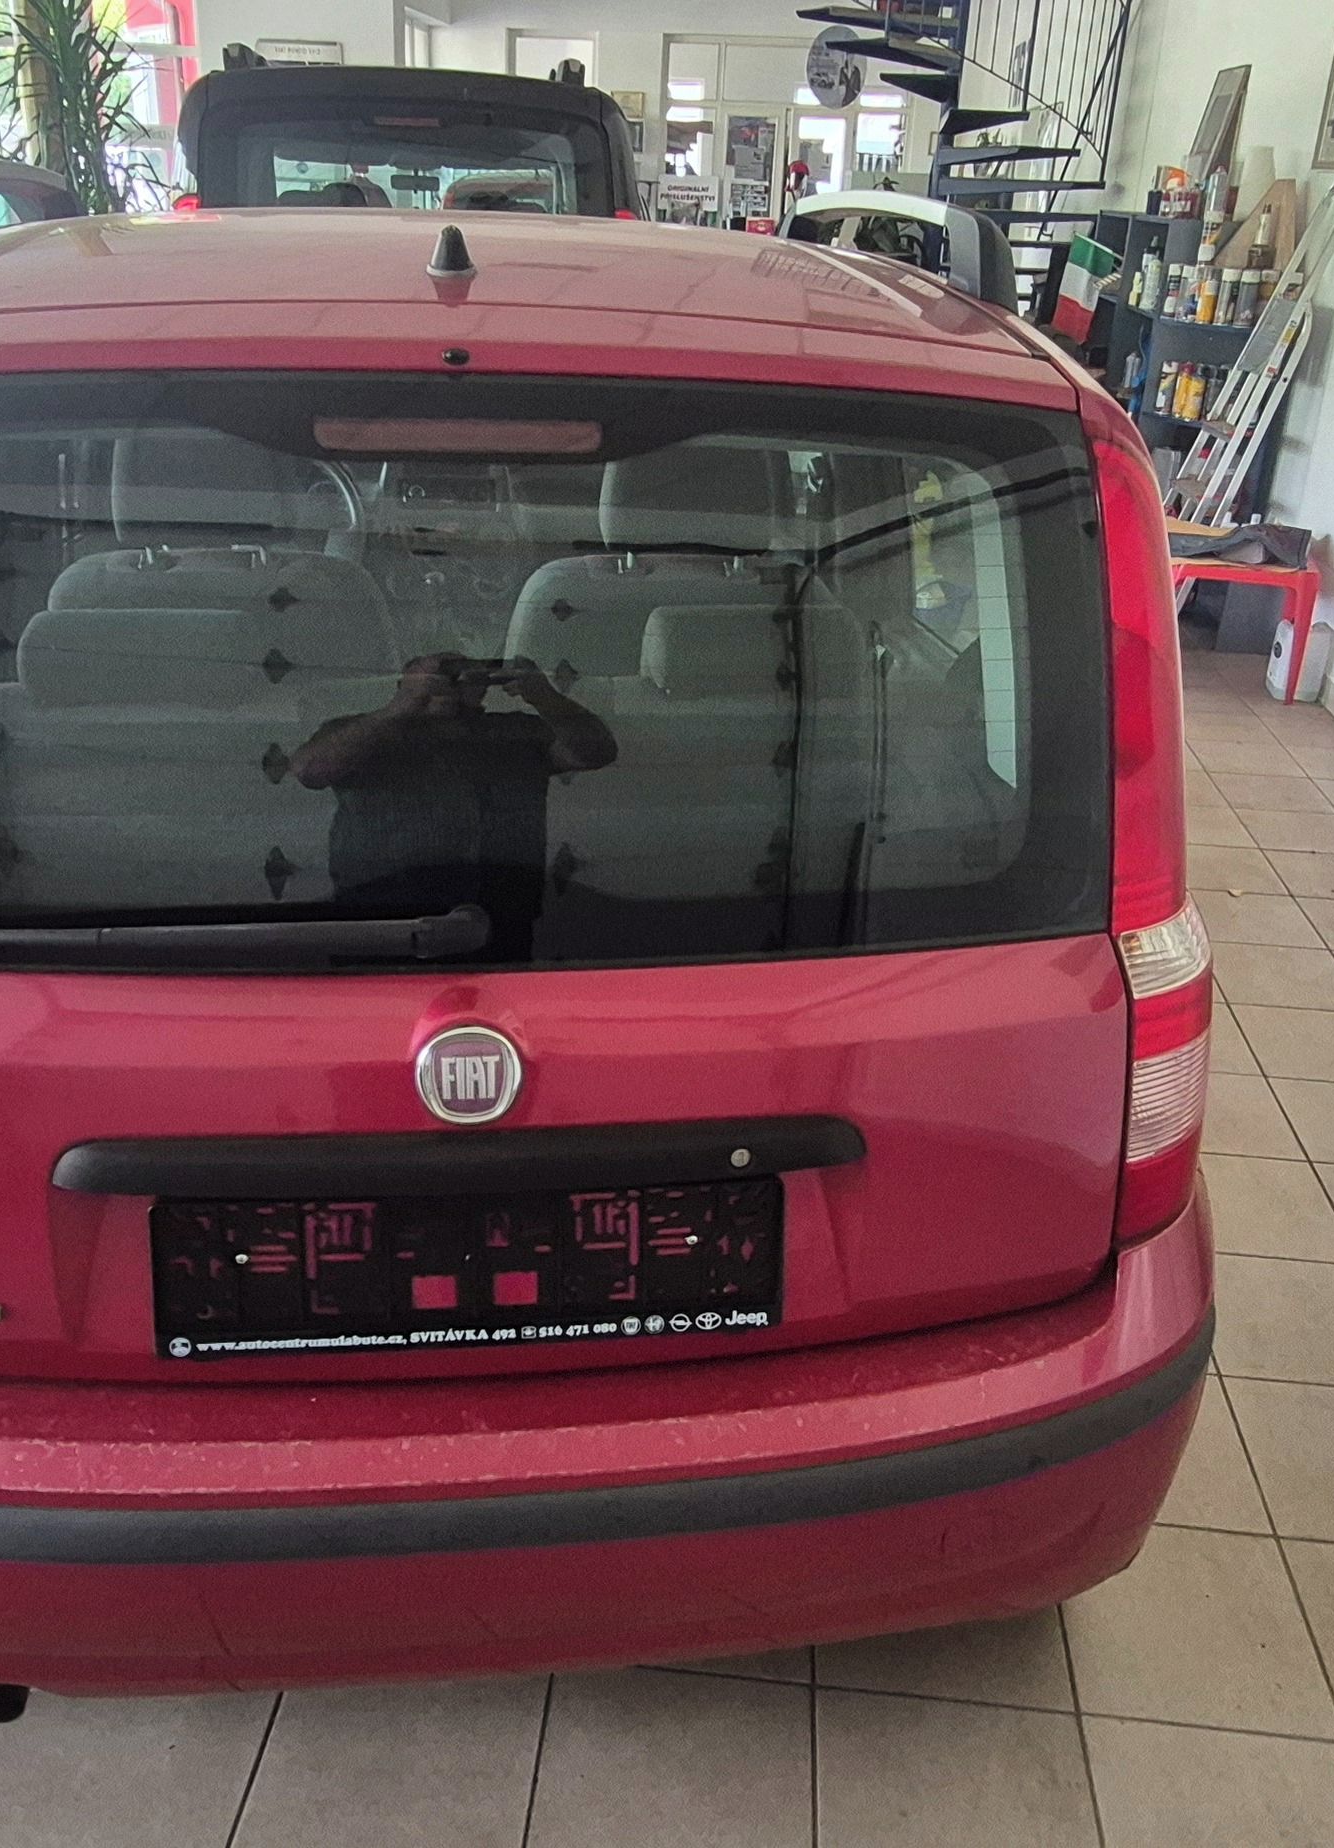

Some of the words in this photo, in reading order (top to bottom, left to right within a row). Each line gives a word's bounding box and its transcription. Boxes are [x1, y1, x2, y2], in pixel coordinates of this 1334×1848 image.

[440, 1054, 501, 1101] FIAT
[410, 1328, 489, 1343] SVITÁVKA
[492, 1328, 517, 1341] 492
[566, 1324, 590, 1336] 471
[592, 1322, 618, 1334] 080
[725, 1309, 769, 1327] Jeep
